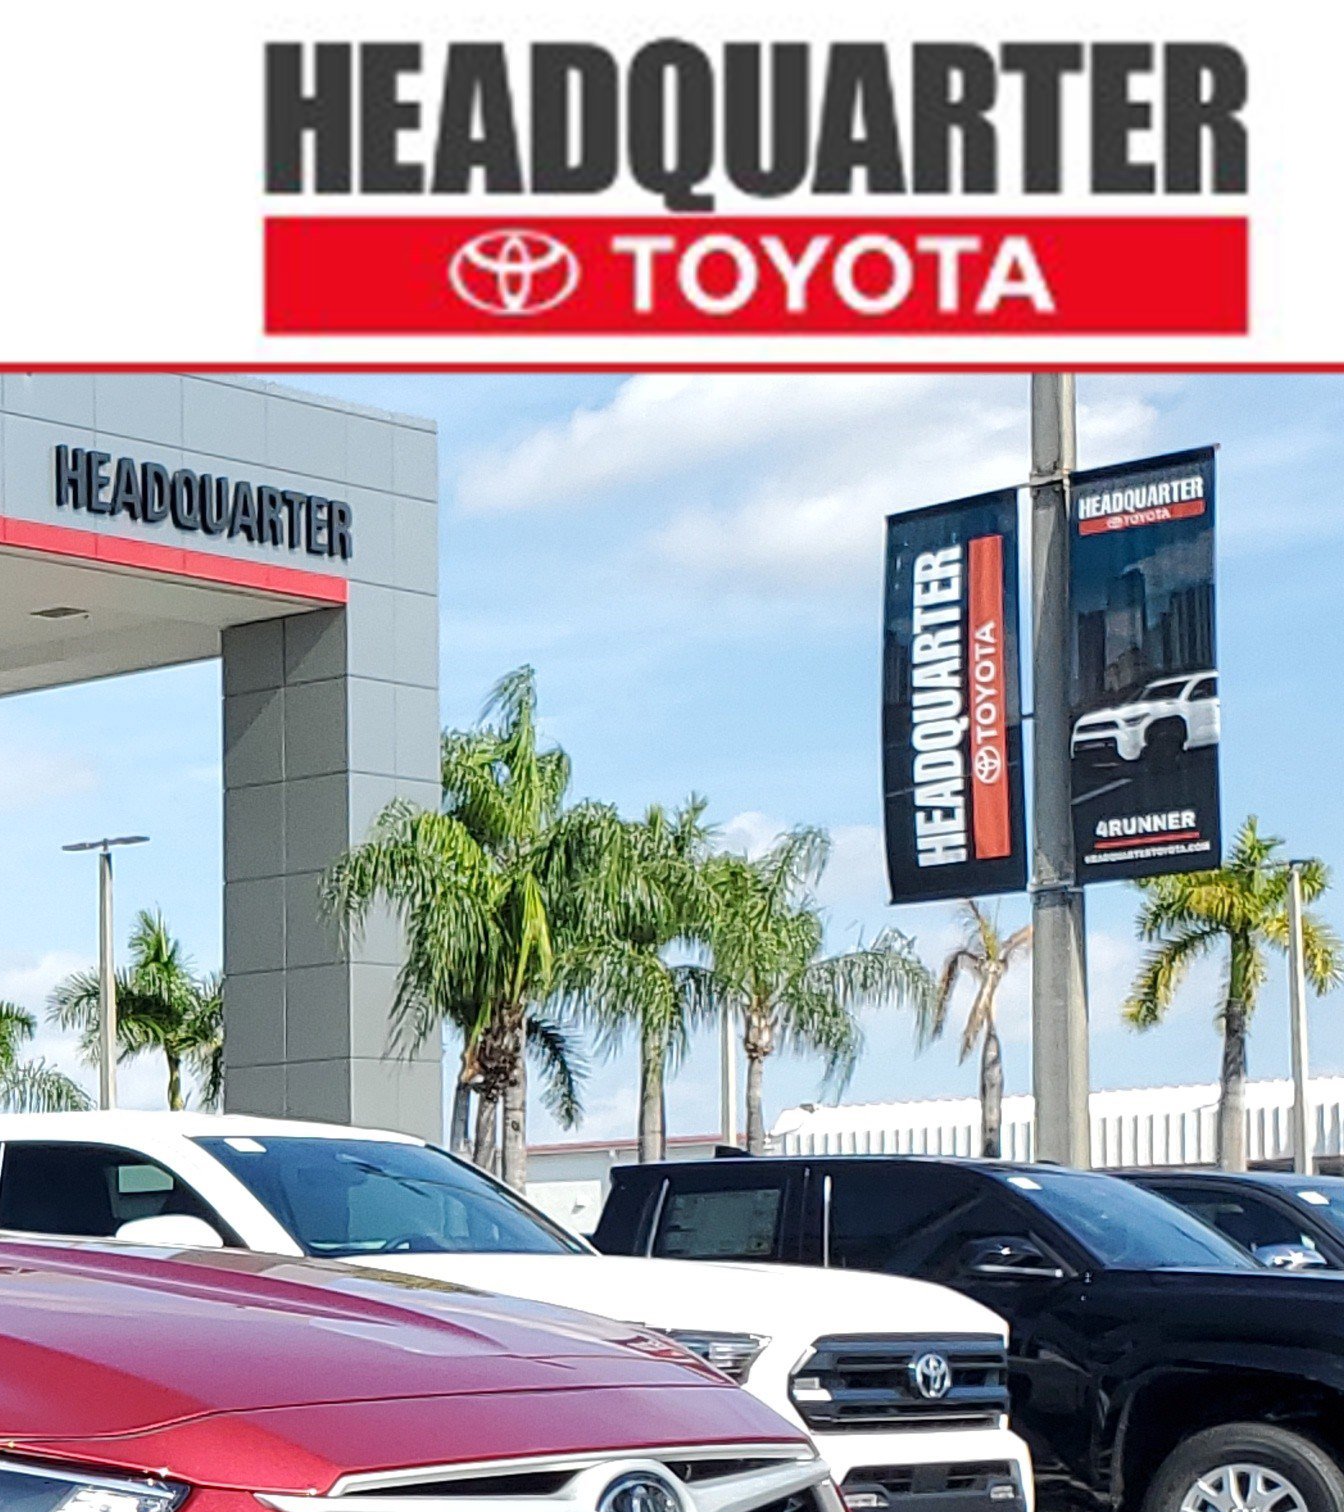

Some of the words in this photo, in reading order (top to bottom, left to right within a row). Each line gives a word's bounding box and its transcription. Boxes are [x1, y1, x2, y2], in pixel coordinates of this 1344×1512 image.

[55, 444, 353, 560] HEADQUARTER
[1078, 475, 1204, 520] HEADQUARTER
[1123, 507, 1172, 524] TOYOTA
[912, 543, 968, 867] HEADQUARTER
[975, 620, 997, 745] TOYOTA
[1095, 810, 1197, 838] 4RUNNER
